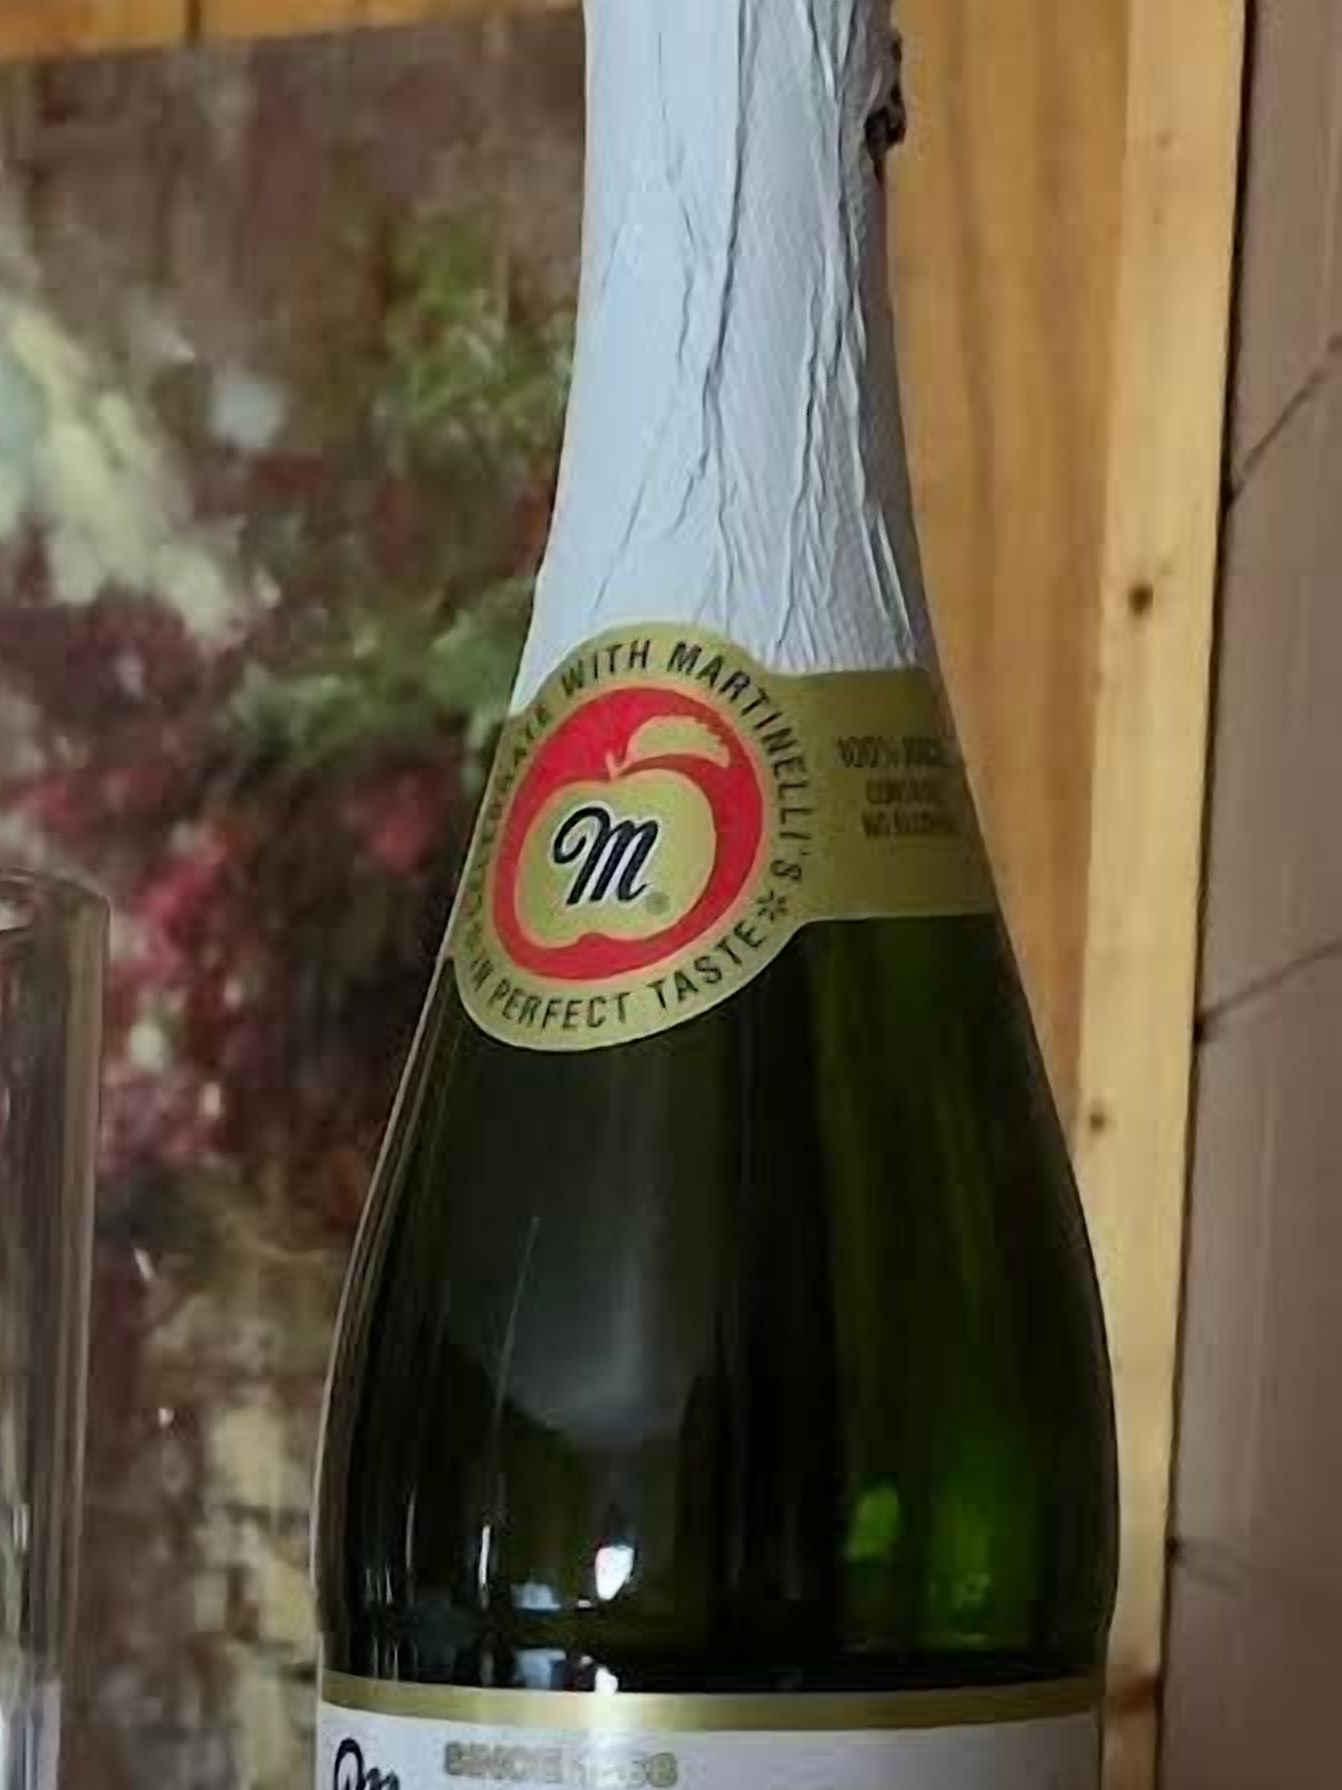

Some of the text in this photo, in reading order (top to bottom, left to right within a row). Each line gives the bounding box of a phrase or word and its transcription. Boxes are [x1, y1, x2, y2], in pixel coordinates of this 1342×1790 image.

[561, 639, 651, 697] WITH
[490, 977, 632, 1030] PERFECT
[647, 919, 767, 1010] TASTE
